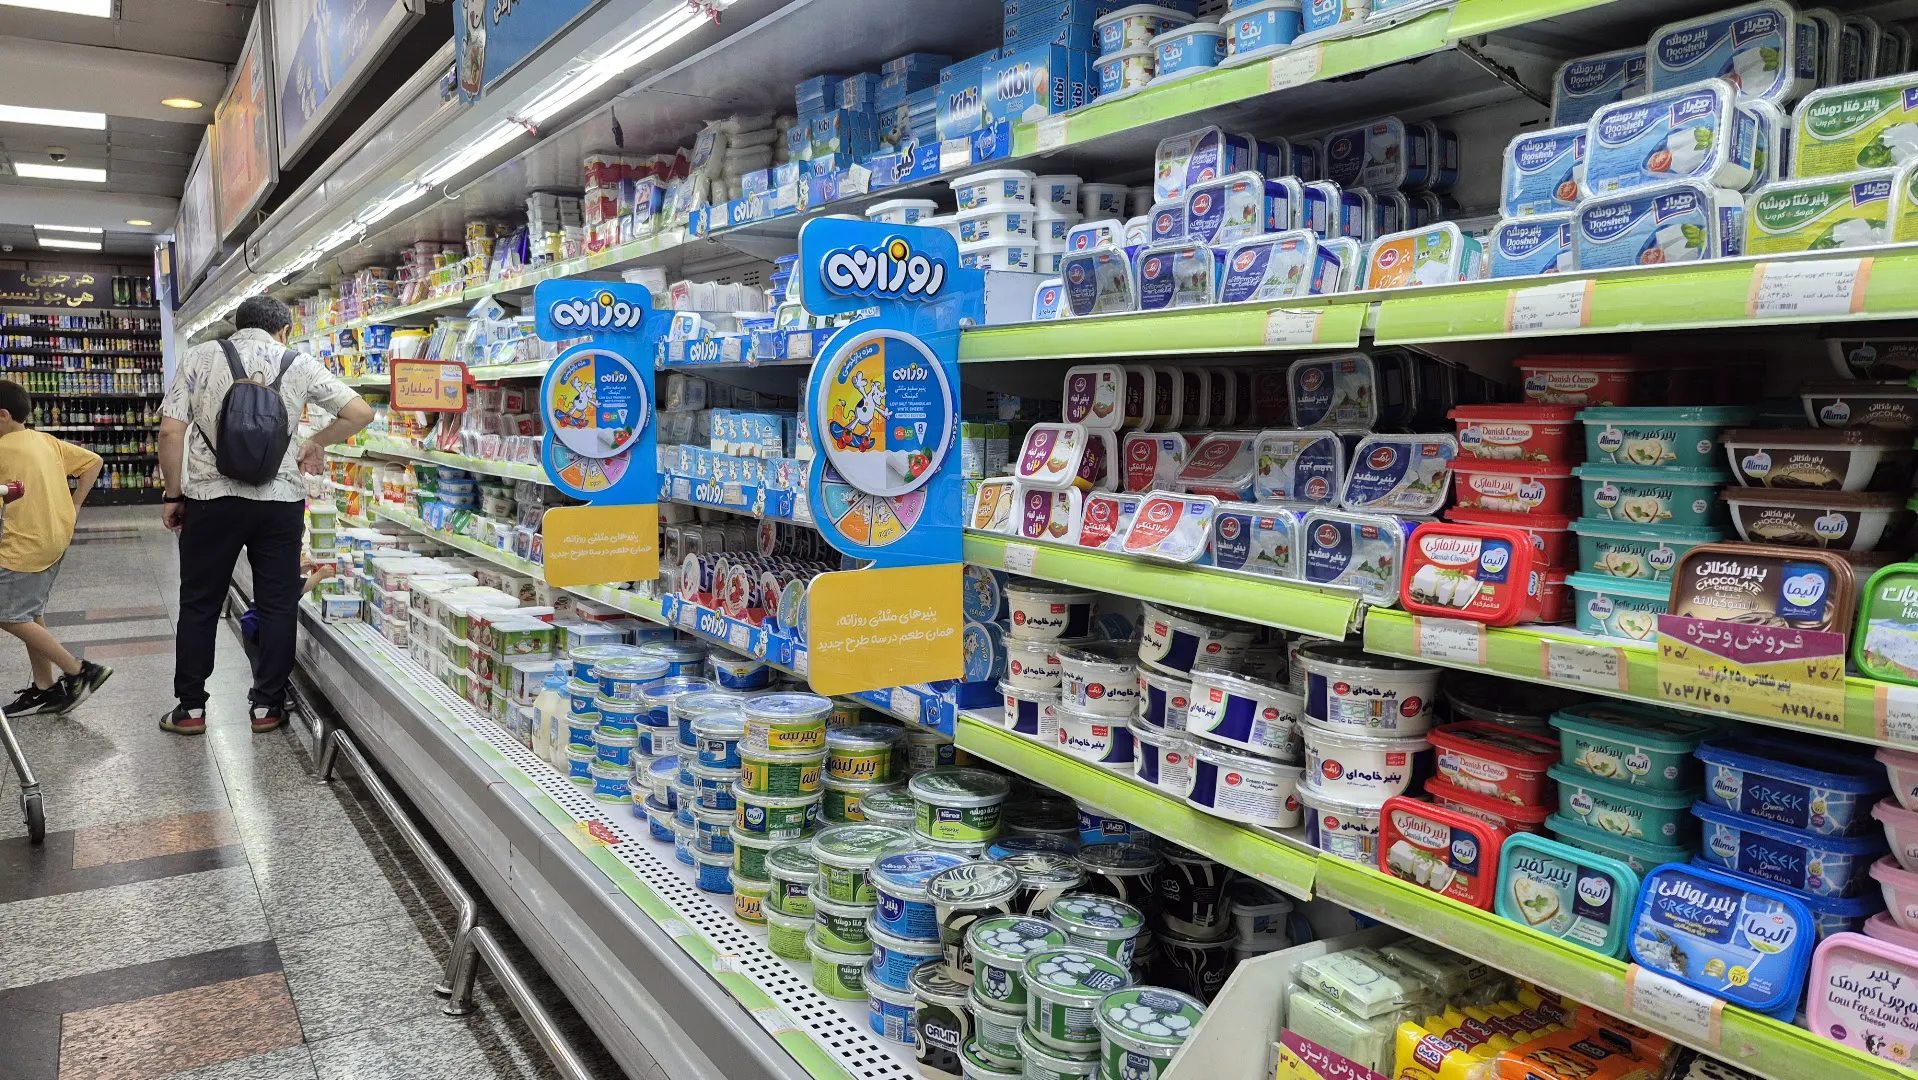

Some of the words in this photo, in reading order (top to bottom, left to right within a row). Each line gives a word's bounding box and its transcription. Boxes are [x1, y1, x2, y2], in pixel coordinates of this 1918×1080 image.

[1739, 16, 1772, 34] طراز
[1666, 41, 1706, 57] Doosheh
[997, 62, 1030, 101] Kibi
[950, 86, 978, 122] Kibi
[1678, 99, 1710, 115] طراز
[1810, 105, 1842, 117] دوشه
[1843, 100, 1861, 111] فتا
[1861, 98, 1880, 112] پنیر
[818, 118, 830, 132] Kibi
[1605, 119, 1644, 134] Doosheh
[1521, 149, 1554, 161] Doosheh
[1859, 182, 1890, 195] طراز
[1662, 196, 1693, 211] طراز
[1759, 197, 1791, 209] دوشه
[1792, 194, 1810, 204] فتا
[1811, 192, 1829, 206] پنیر
[1590, 215, 1630, 230] Doosheh
[1506, 237, 1539, 247] Doosheh
[828, 240, 943, 295] روزانه
[75, 274, 95, 288] هر
[1374, 268, 1406, 288] شیرازی
[554, 297, 640, 327] روزانه
[690, 338, 718, 361] روزانه
[601, 371, 628, 383] روزانه
[893, 364, 928, 380] روزانه
[1548, 374, 1571, 383] Danish
[1572, 374, 1596, 383] Cheese
[1823, 410, 1848, 421] Alima
[918, 424, 923, 432] 8
[1483, 427, 1504, 436] Danish
[1506, 427, 1530, 436] Cheese
[1640, 429, 1663, 440] کفیر
[1461, 434, 1481, 444] Alima
[1599, 435, 1620, 446] Alima
[1661, 431, 1677, 442] پنیر
[1744, 459, 1768, 471] Alima
[1782, 462, 1832, 476] CHOCOLATE
[696, 480, 724, 505] روزانه
[1596, 492, 1617, 502] Alima
[1753, 518, 1803, 531] CHOCOLATE
[1817, 520, 1844, 533] آلیما
[611, 547, 629, 555] طعم
[631, 546, 652, 554] همان
[1425, 538, 1461, 552] دانمارکی
[1460, 542, 1477, 558] پنیر
[571, 549, 588, 560] طرح
[1431, 552, 1451, 561] Danish
[1453, 554, 1470, 564] Cheese
[1483, 555, 1505, 566] آلیما
[1650, 552, 1673, 565] آلیما
[1696, 561, 1743, 579] شکلاتی
[1742, 565, 1768, 584] پنیر
[1696, 577, 1764, 596] CHOCOLATE
[1713, 585, 1743, 593] CHEESE
[1784, 581, 1823, 600] آلیما
[869, 609, 897, 627] مثلثی
[900, 607, 936, 623] پنیرهای
[701, 612, 728, 639] روزانه
[871, 635, 886, 644] سه
[887, 634, 897, 645] در
[899, 630, 924, 645] طعم
[926, 628, 955, 641] همان
[1687, 622, 1732, 648] ویژه
[1735, 628, 1803, 654] فروش
[817, 641, 844, 652] جدید
[845, 635, 869, 652] طرح
[1777, 680, 1792, 695] پنیر
[779, 730, 802, 741] لبنه
[801, 731, 818, 744] پنیر
[831, 758, 852, 771] لبنه
[852, 758, 877, 777] پنیر
[1460, 758, 1481, 771] Danish
[1482, 764, 1505, 776] Cheese
[1346, 769, 1357, 779] ای
[1358, 771, 1382, 781] خامه
[1383, 771, 1402, 783] پنیر
[1715, 780, 1738, 793] Alima
[1749, 785, 1803, 811] GREEK
[1762, 802, 1784, 812] Cheese
[1397, 816, 1431, 833] دانمارکی
[1432, 828, 1448, 843] پنیر
[1712, 838, 1735, 851] Alima
[1745, 844, 1799, 872] GREEK
[1514, 858, 1553, 874] کفیر
[1760, 861, 1781, 871] Cheese
[1544, 868, 1572, 888] پنیر
[1581, 887, 1608, 899] آلیما
[1658, 881, 1707, 905] یونانی
[1658, 897, 1702, 921] GREEK
[1703, 914, 1729, 927] Cheese
[1703, 895, 1738, 920] پنیر
[1747, 919, 1794, 944] آلیما
[1830, 975, 1859, 993] نمک
[1858, 987, 1881, 999] کم
[1828, 991, 1850, 1007] Low
[1852, 999, 1868, 1013] Fat
[1869, 1008, 1875, 1016] &
[1876, 1008, 1900, 1025] Low
[1879, 992, 1905, 1013] چرب
[1860, 1014, 1886, 1028] Cheese
[1299, 1041, 1329, 1068] ویژه
